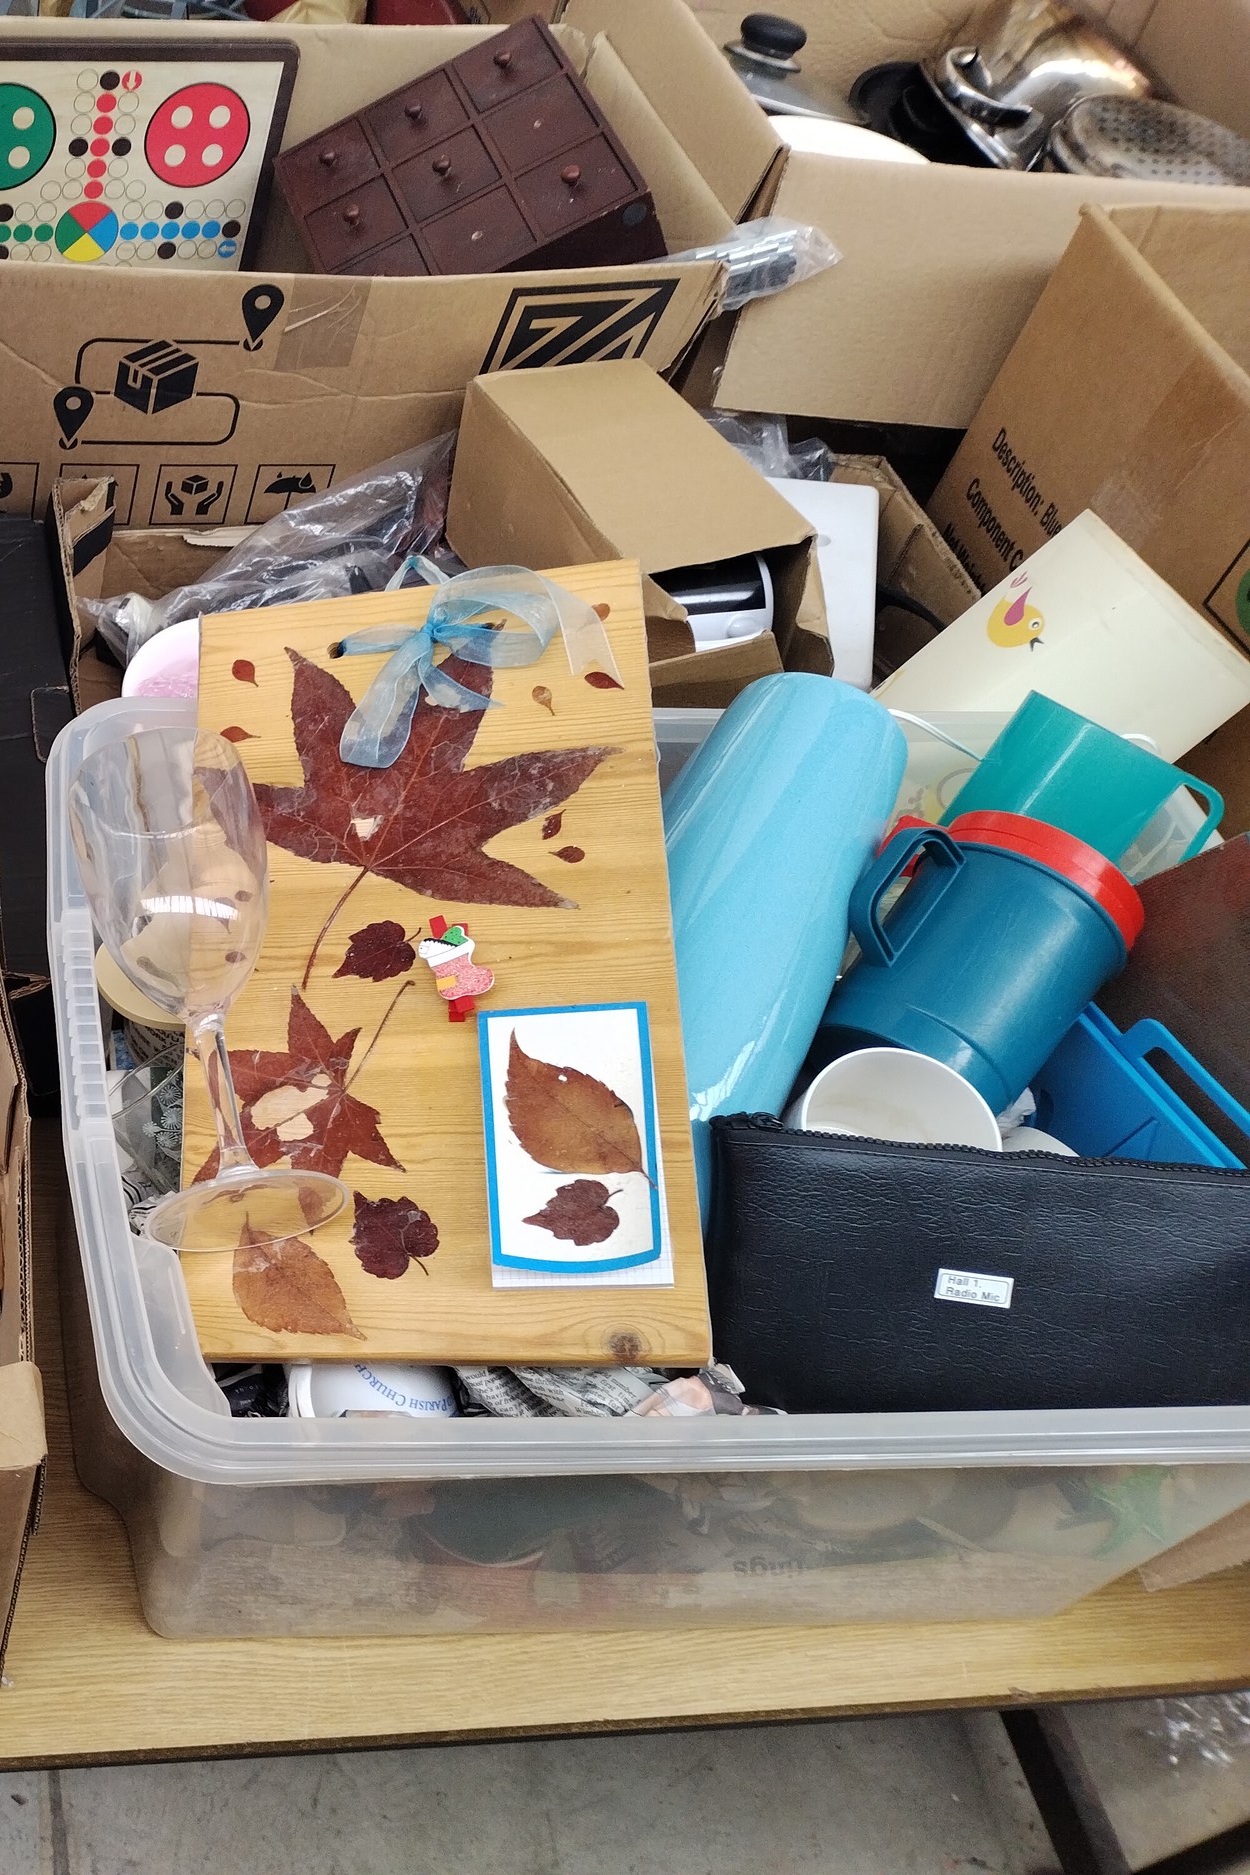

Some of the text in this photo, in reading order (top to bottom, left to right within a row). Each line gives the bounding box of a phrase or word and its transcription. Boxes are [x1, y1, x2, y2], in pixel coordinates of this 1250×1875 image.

[991, 427, 1045, 517] Description:
[966, 477, 1016, 563] Component
[947, 1275, 970, 1286] Hall
[946, 1286, 1001, 1302] Radio Mic
[409, 1399, 448, 1412] PARISH
